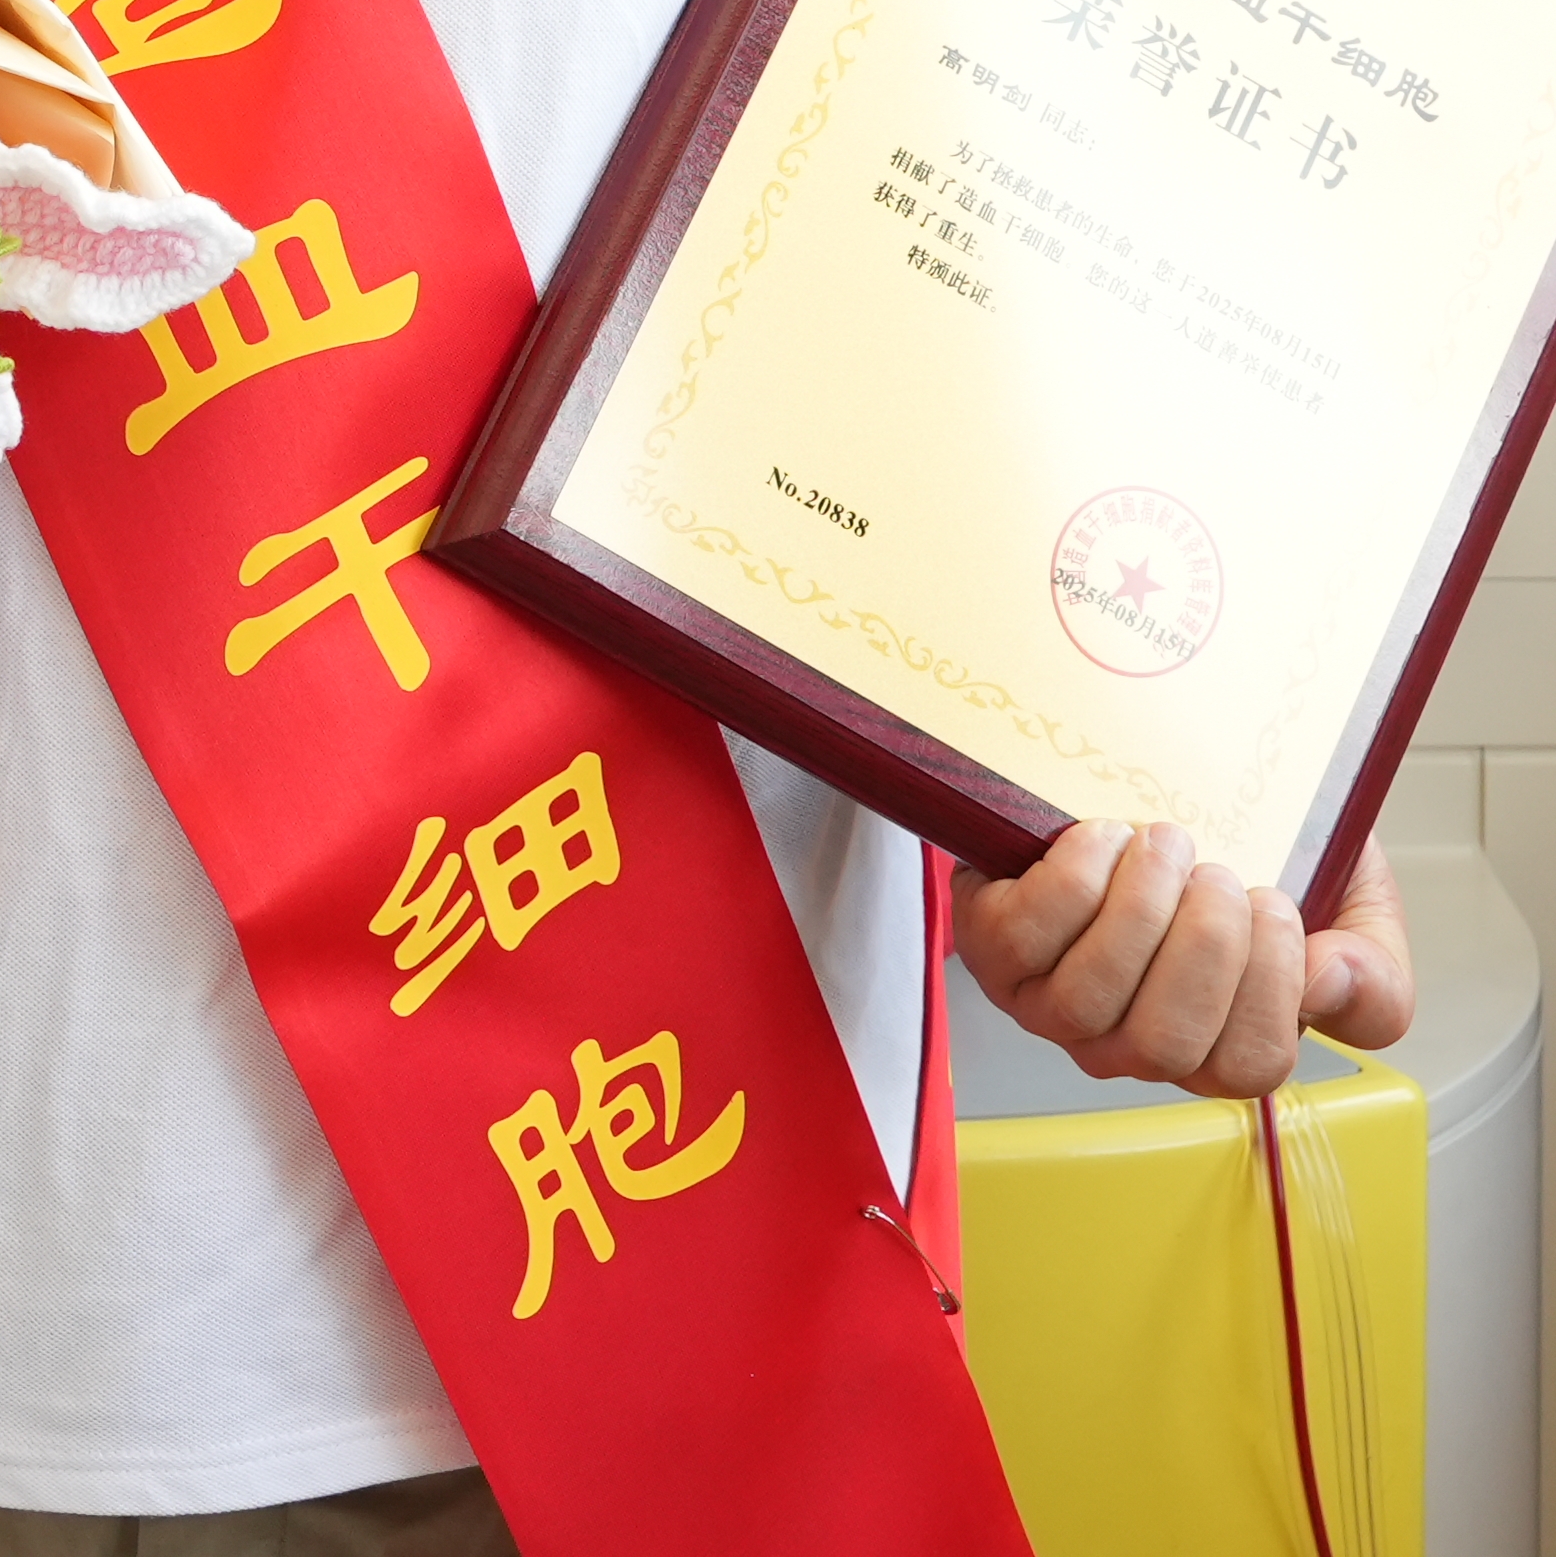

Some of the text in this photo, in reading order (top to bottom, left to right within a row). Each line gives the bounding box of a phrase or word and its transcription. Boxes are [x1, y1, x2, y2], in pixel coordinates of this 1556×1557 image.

[936, 43, 1033, 114] 高明剑
[871, 179, 986, 264] 获得了重生。
[905, 242, 1000, 316] 特颁此证。
[764, 464, 872, 539] No.20838
